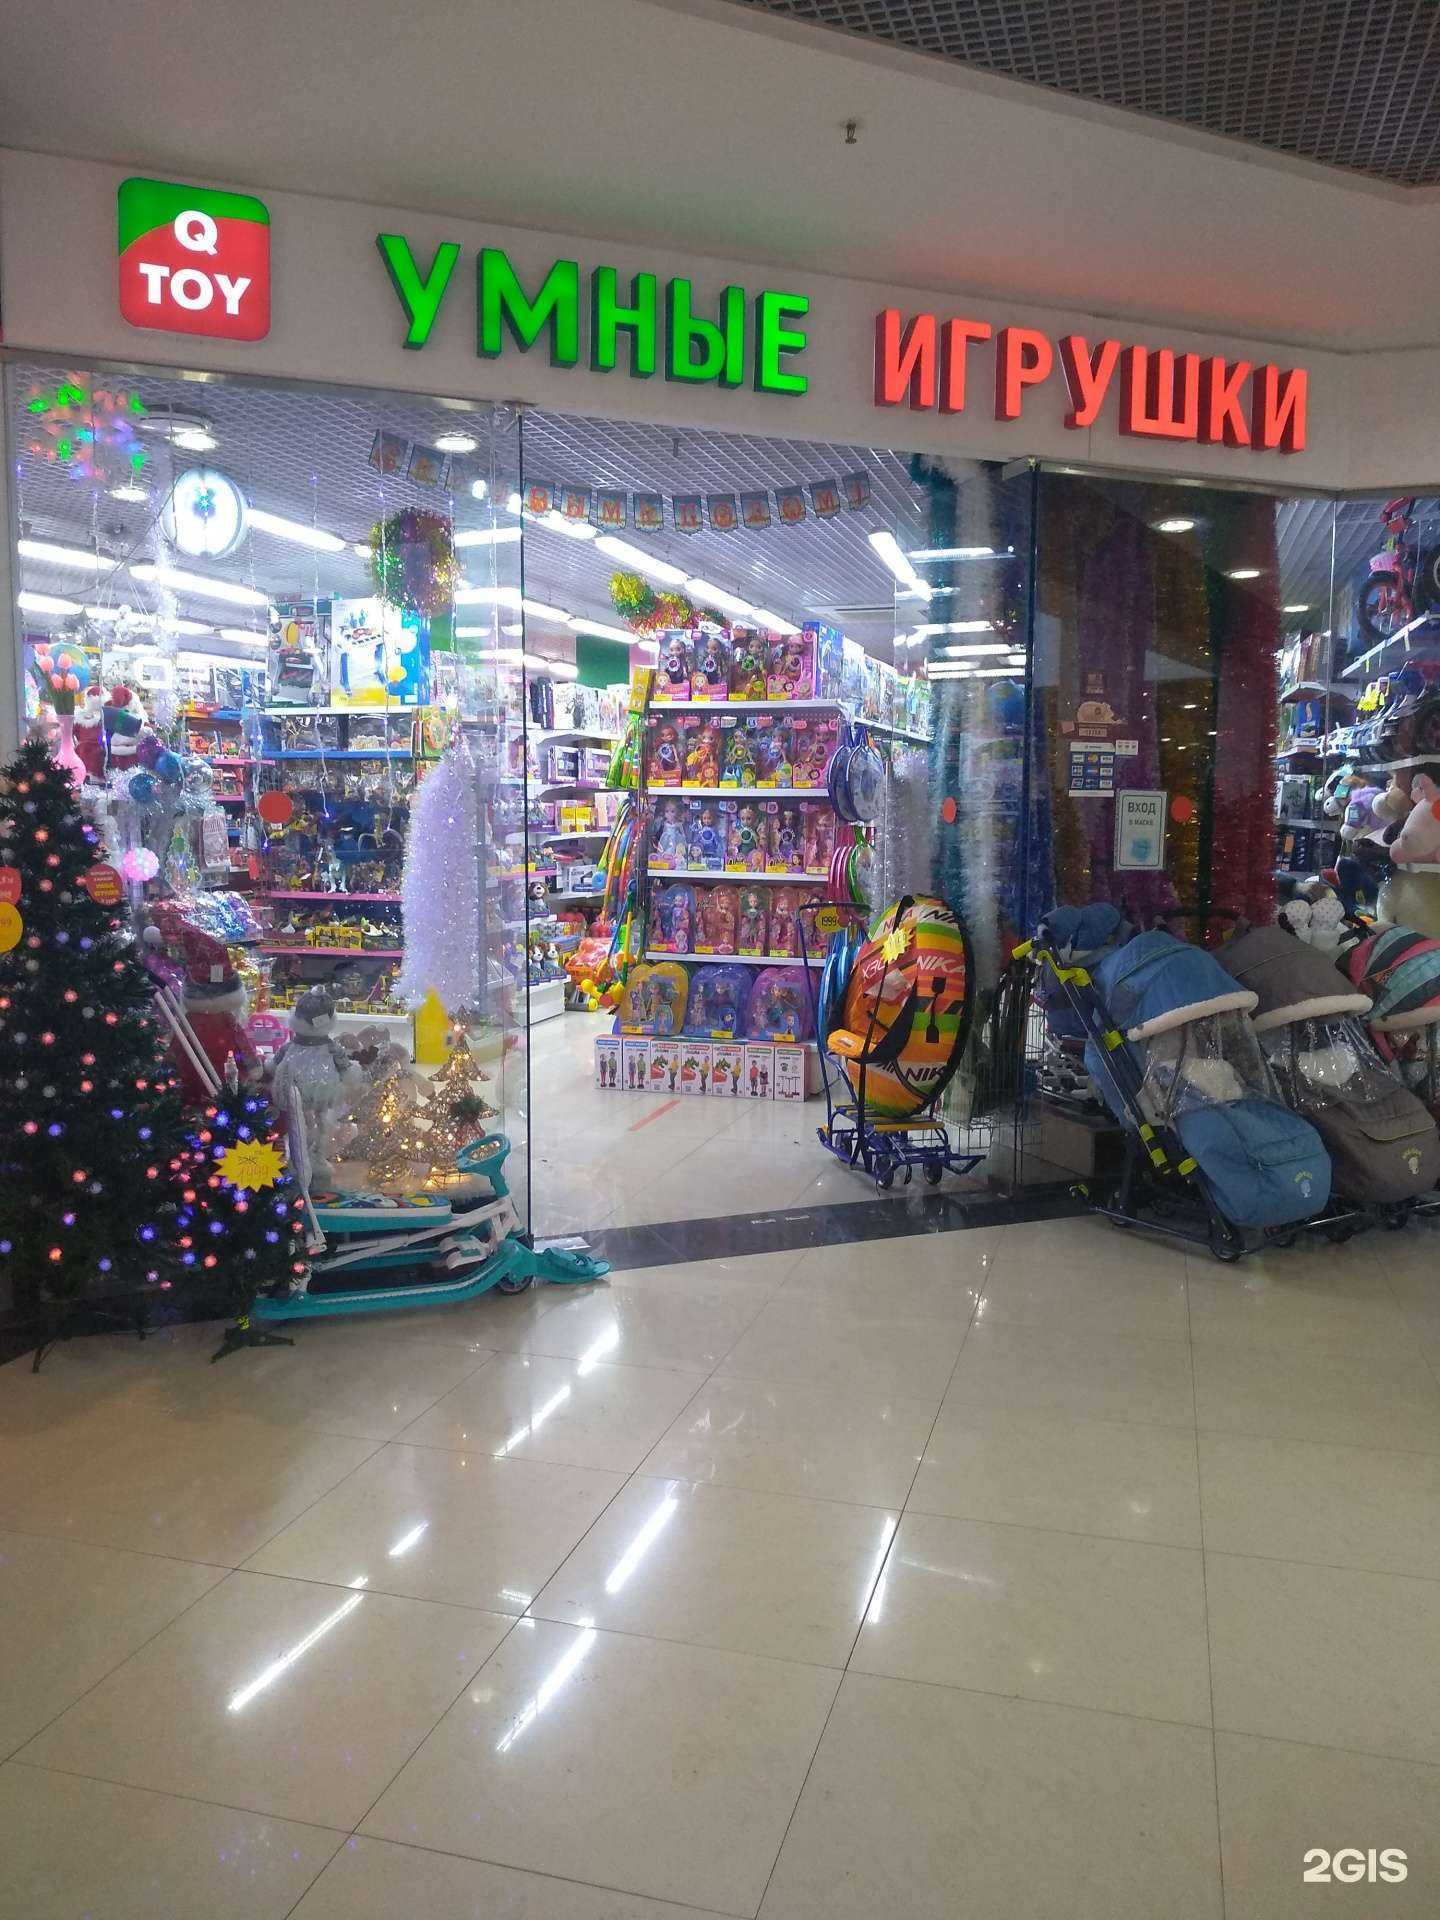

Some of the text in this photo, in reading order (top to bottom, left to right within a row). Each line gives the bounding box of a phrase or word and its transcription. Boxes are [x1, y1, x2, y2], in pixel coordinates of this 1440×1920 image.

[174, 210, 218, 256] Q
[139, 262, 251, 316] TOY
[376, 233, 1308, 454] УМНЫЕ ИГРУШКИ
[1127, 801, 1156, 816] ВХОД
[821, 916, 837, 926] 1999
